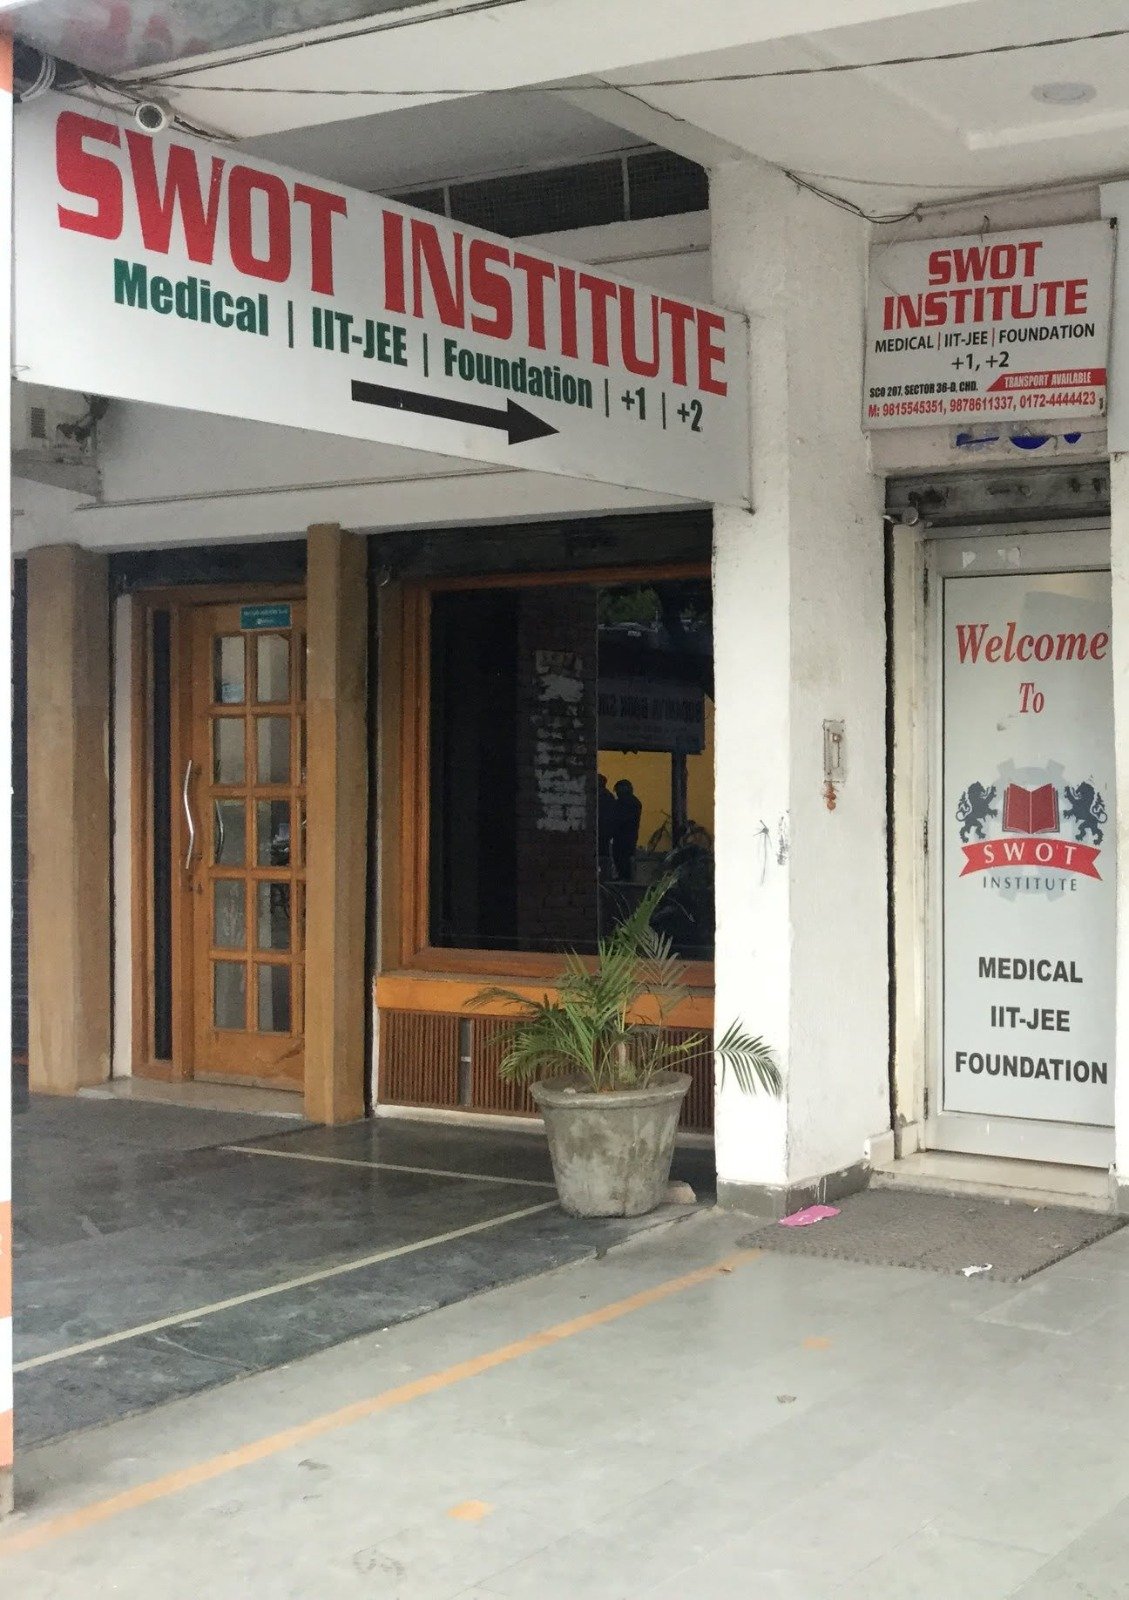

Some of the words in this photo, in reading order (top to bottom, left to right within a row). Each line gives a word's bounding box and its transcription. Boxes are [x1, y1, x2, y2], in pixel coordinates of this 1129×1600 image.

[56, 110, 347, 296] SWOT
[382, 209, 727, 397] INSTITUTE
[929, 241, 1043, 286] SWOT
[883, 278, 1088, 331] INSTITUTE
[114, 258, 269, 336] Medical
[312, 306, 408, 367] IIT-JEE
[444, 338, 592, 409] Foundation
[621, 387, 646, 420] +1
[676, 399, 703, 432] +2
[875, 335, 934, 353] MEDICAL
[944, 331, 988, 348] IIT-JEE
[999, 323, 1095, 344] FOUNDATION
[951, 353, 981, 372] +1,
[986, 351, 1010, 368] +2
[869, 387, 885, 398] SCO
[904, 383, 935, 396] SECTOR
[1005, 374, 1049, 389] TRANSPORT
[1051, 371, 1091, 385] AVAILABLE
[868, 404, 880, 418] M:
[882, 399, 947, 417] 9815545351,
[949, 394, 1016, 412] 9878611337,
[1019, 391, 1096, 408] 0172-4444423
[956, 621, 1109, 664] Welcome
[1019, 682, 1045, 714] To
[983, 842, 1077, 866] SWOT
[983, 876, 1077, 892] INSTITUTE
[978, 956, 1083, 983] MEDICAL
[991, 1005, 1070, 1032] IIT-JEE
[955, 1051, 1107, 1084] FOUNDATION
